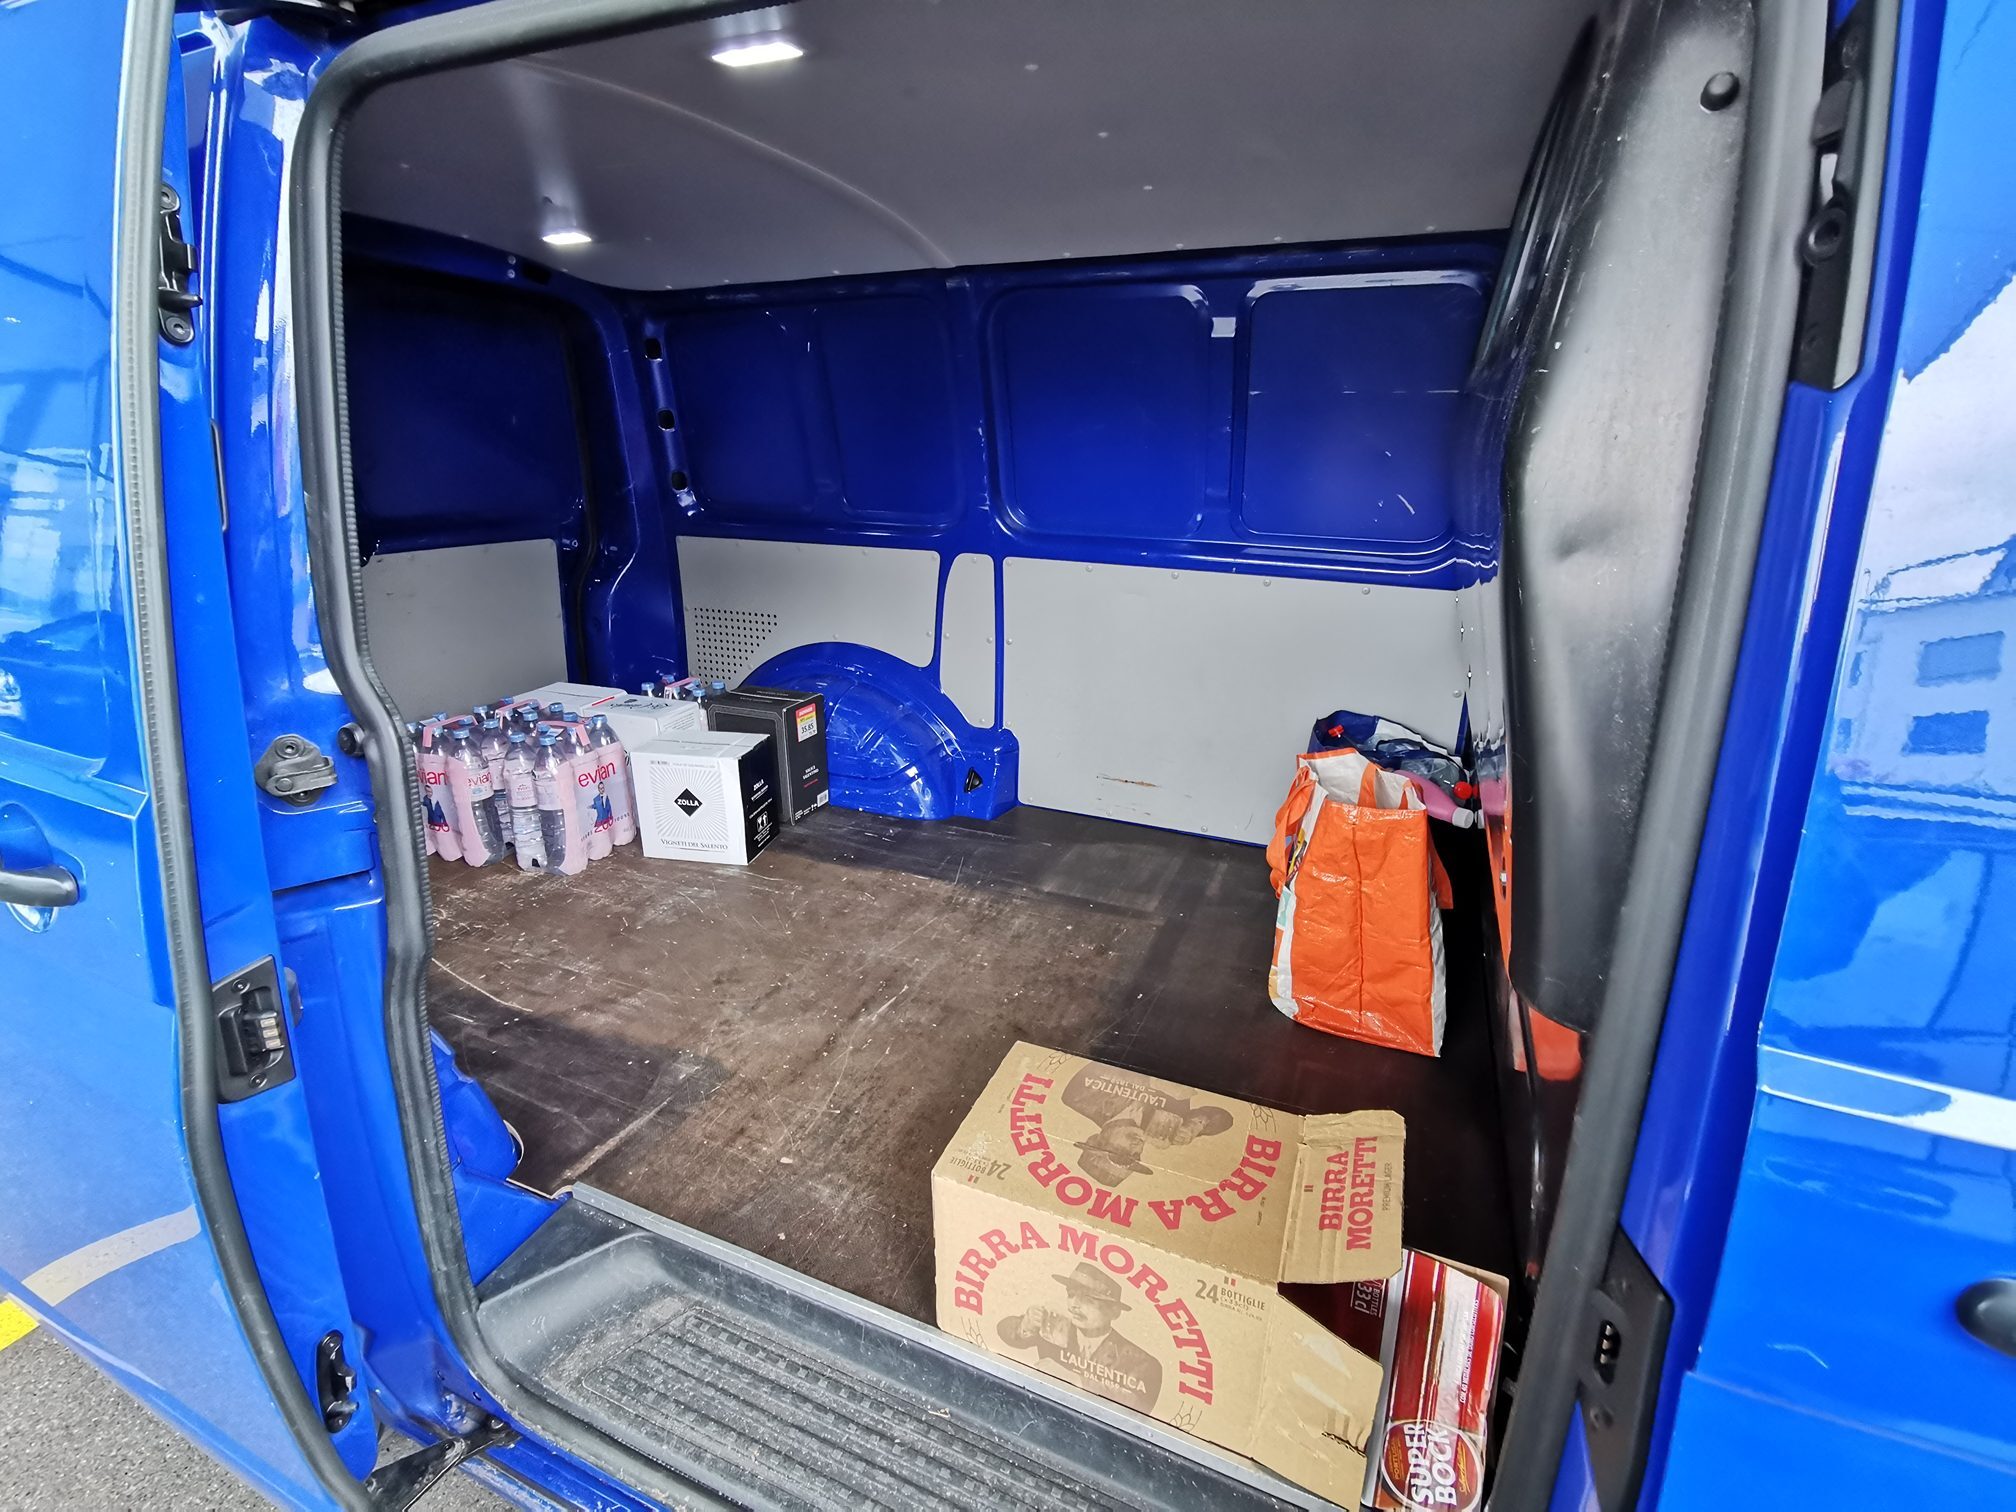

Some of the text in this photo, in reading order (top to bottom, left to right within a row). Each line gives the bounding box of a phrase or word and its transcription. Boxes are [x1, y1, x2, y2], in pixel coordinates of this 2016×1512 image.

[417, 768, 448, 785] vian
[578, 762, 616, 788] evian
[677, 799, 700, 807] ZOLLA
[660, 838, 687, 847] VIGNETI
[700, 842, 729, 850] SALENTO
[1084, 1077, 1167, 1108] L'AUTENTICA
[1009, 1073, 1283, 1231] BIRRA MORETTI
[950, 1156, 1012, 1180] 24 BOTTIGLIE
[1319, 1151, 1348, 1231] BIRRA
[1346, 1136, 1377, 1250] MORETTI
[1195, 1279, 1266, 1310] 24 BOTTIGLIE
[1370, 1288, 1380, 1316] BOTTLES
[955, 1221, 1214, 1406] BIRRA MORETTI
[1060, 1349, 1147, 1394] L'AUTENTICA
[1083, 1370, 1100, 1383] DAL
[1403, 1423, 1434, 1505] SUPER
[1427, 1428, 1456, 1506] BOCK
